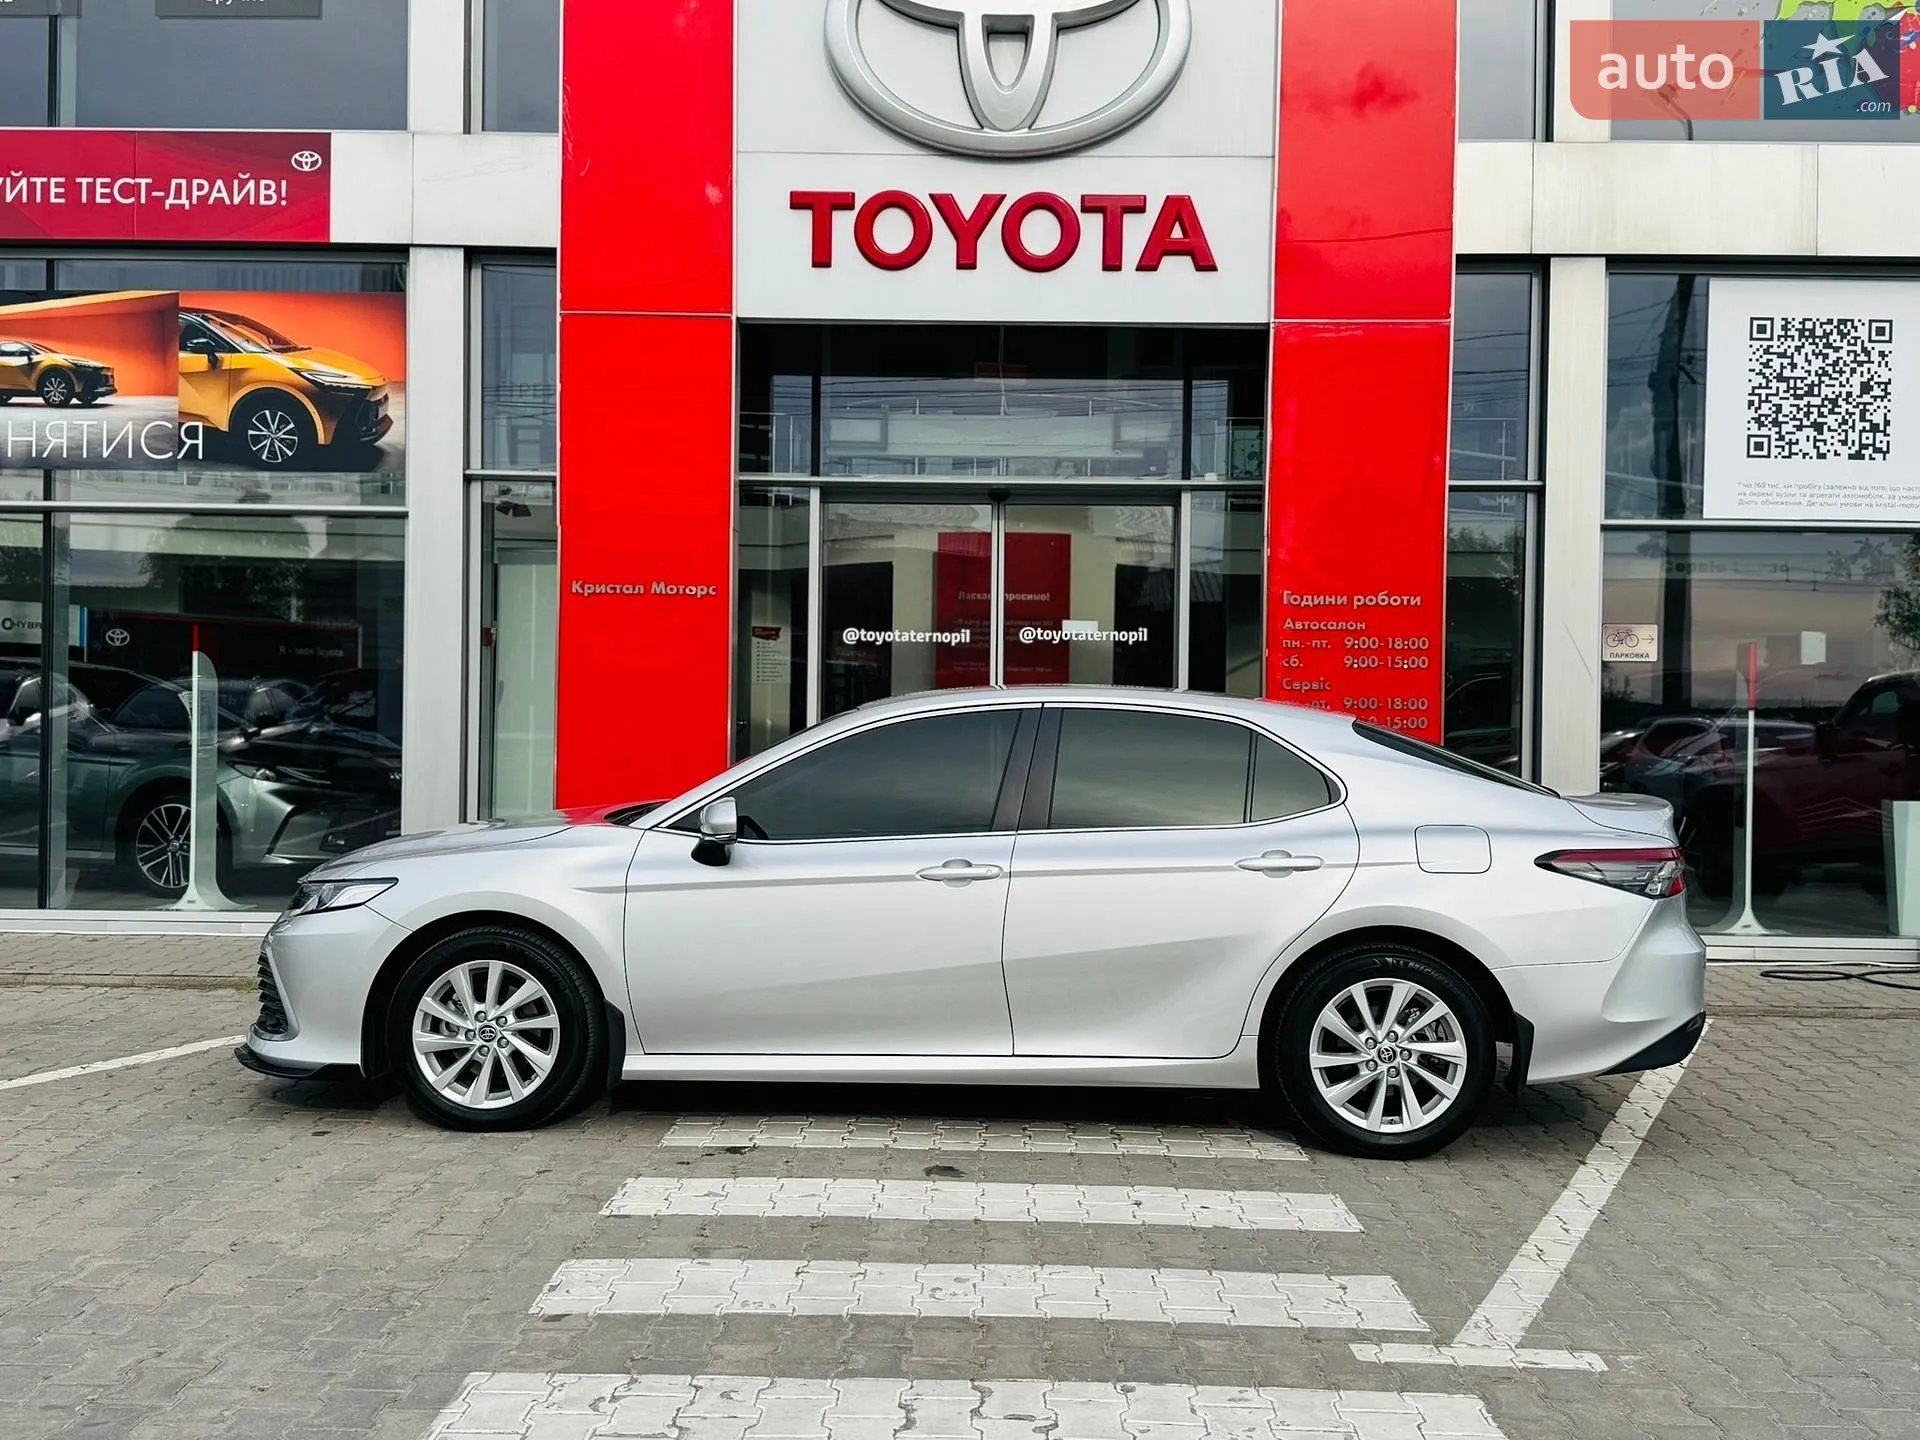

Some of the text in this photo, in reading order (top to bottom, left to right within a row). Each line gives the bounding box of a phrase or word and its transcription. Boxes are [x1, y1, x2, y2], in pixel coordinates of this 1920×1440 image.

[75, 172, 288, 210] ТЕСТ-ДРАЙВ!
[789, 189, 1218, 273] TOYOTA
[7, 419, 204, 460] НЯТИСЯ
[572, 580, 717, 598] Кристал Моторс
[1283, 590, 1421, 609] Години роботи
[1283, 618, 1366, 630] Автосалон
[843, 627, 971, 646] @toyotaternopil
[1019, 626, 1148, 645] @toyotaternopil
[1282, 638, 1331, 649] пн.-пт.
[1282, 654, 1304, 667] сб.
[1282, 677, 1332, 693] Сервіс
